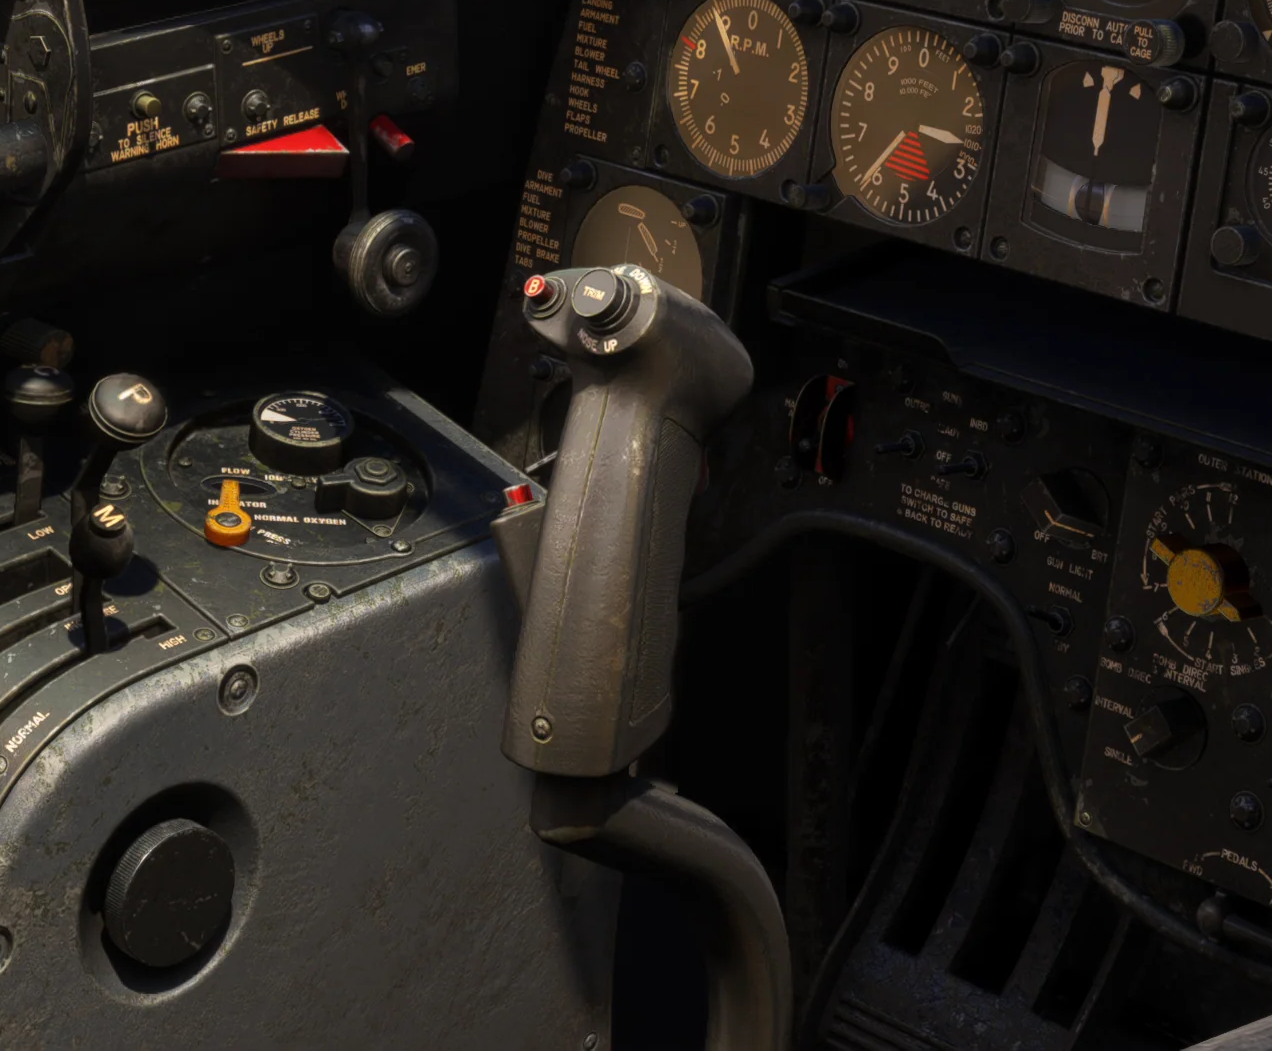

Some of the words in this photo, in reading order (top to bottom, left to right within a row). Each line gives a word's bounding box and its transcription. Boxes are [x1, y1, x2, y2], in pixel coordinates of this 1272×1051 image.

[580, 8, 620, 26] ARMAMENT
[1062, 11, 1100, 29] DISCONN
[578, 21, 597, 35] FUEL
[1059, 22, 1085, 37] PRIOR
[1092, 29, 1104, 41] TO
[1133, 25, 1153, 38] PULL
[251, 29, 285, 46] WHEELS
[576, 33, 608, 50] MIXTURE
[731, 35, 770, 57] R.P.M.
[574, 46, 606, 62] BLOWER
[1129, 46, 1152, 60] CAGE
[406, 62, 426, 76] EMER
[573, 59, 591, 73] TAIL
[595, 64, 620, 80] WHEEL
[571, 72, 606, 89] HARNESS
[569, 85, 590, 98] HOOK
[568, 97, 598, 114] WHEELS
[245, 118, 279, 137] SAFETY
[283, 108, 320, 127] RELEASE
[566, 110, 591, 125] FLAPS
[126, 116, 159, 137] PUSH
[564, 122, 608, 143] PROPELLER
[118, 138, 130, 150] TO
[136, 126, 172, 146] SILENCE
[110, 144, 149, 164] WARNING
[156, 134, 179, 151] HORN
[537, 169, 553, 182] DIVE
[524, 180, 563, 198] ARMAMENT
[522, 192, 541, 206] FUEL
[520, 205, 552, 222] MIXTURE
[519, 218, 549, 234] BLOWER
[517, 230, 559, 249] PROPELLER
[515, 242, 532, 255] DIVE
[535, 248, 560, 264] BRAKE
[515, 254, 533, 268] TABS
[583, 286, 605, 301] TRIM
[604, 339, 618, 353] UP
[936, 450, 953, 463] OFF
[221, 467, 250, 475] FLOW
[901, 483, 912, 495] TO
[952, 501, 977, 517] GUNS
[254, 514, 300, 524] NORMAL
[303, 516, 347, 526] OXYGEN
[904, 508, 928, 525] BACK
[930, 517, 942, 528] TO
[936, 508, 948, 519] TO
[950, 512, 973, 527] SAFE
[28, 525, 55, 541] LOW
[1034, 530, 1050, 543] OFF
[1048, 581, 1083, 604] NORMAL
[158, 634, 188, 651] HIGH
[4, 710, 51, 753] NORMAL
[1221, 848, 1258, 872] PEDALS
